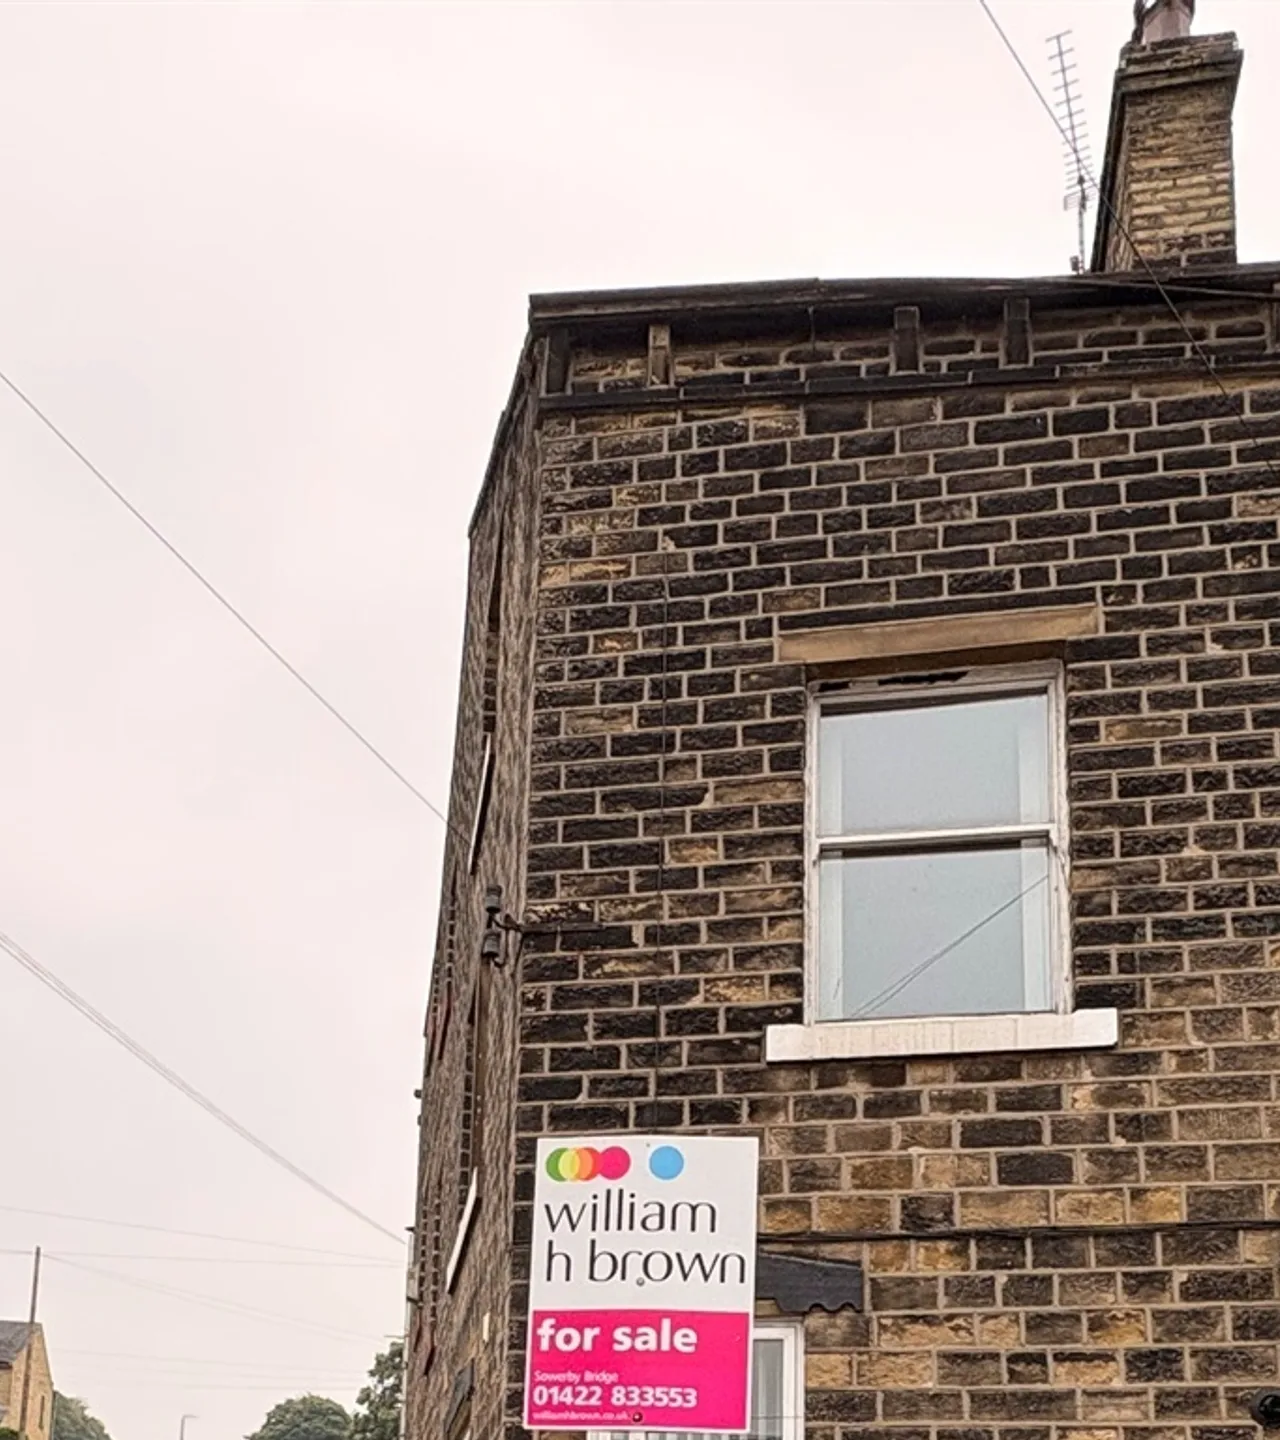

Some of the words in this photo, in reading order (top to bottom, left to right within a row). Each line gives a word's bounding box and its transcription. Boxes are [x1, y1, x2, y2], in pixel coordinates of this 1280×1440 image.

[544, 1188, 717, 1233] william
[546, 1239, 572, 1282] h
[588, 1238, 746, 1284] brown
[536, 1317, 601, 1352] for
[612, 1317, 698, 1354] sale
[533, 1370, 581, 1385] Sowerby
[583, 1370, 620, 1385] Bridge
[532, 1385, 603, 1406] 01422
[610, 1385, 698, 1408] 833553
